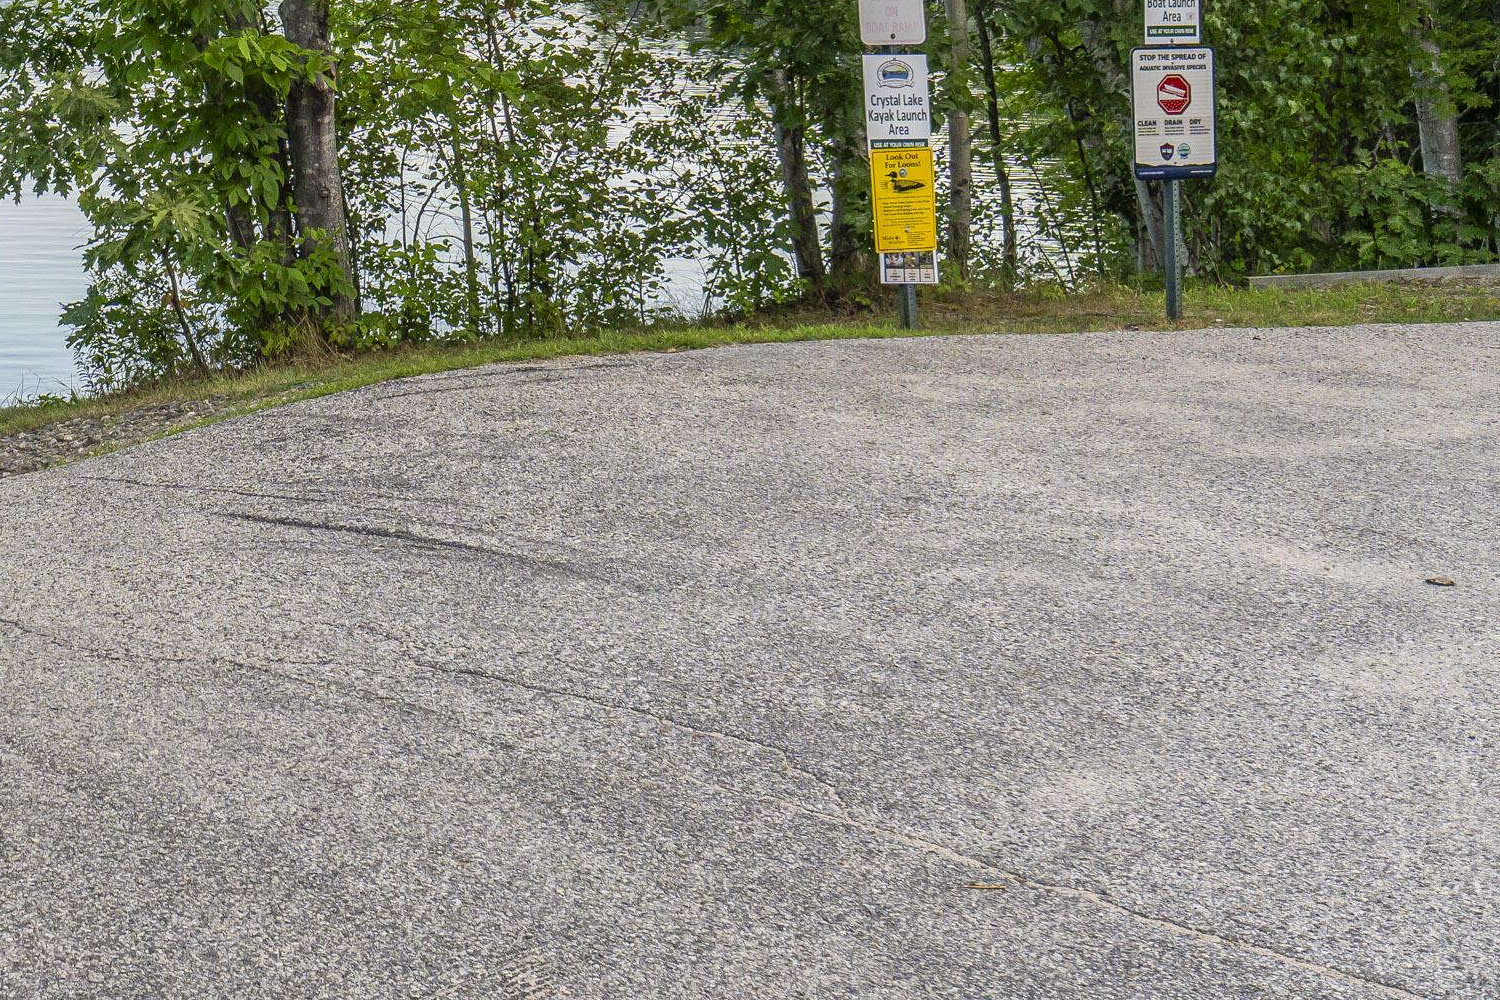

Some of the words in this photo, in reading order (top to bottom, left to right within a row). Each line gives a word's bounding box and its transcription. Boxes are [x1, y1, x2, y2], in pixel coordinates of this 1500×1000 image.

[1162, 11, 1182, 22] Area
[870, 94, 901, 108] Crystal
[903, 94, 923, 106] Lake
[868, 110, 894, 124] Kayak
[896, 109, 927, 121] Launch
[888, 124, 909, 135] Area
[885, 161, 896, 169] For
[897, 160, 921, 168] Loons!
